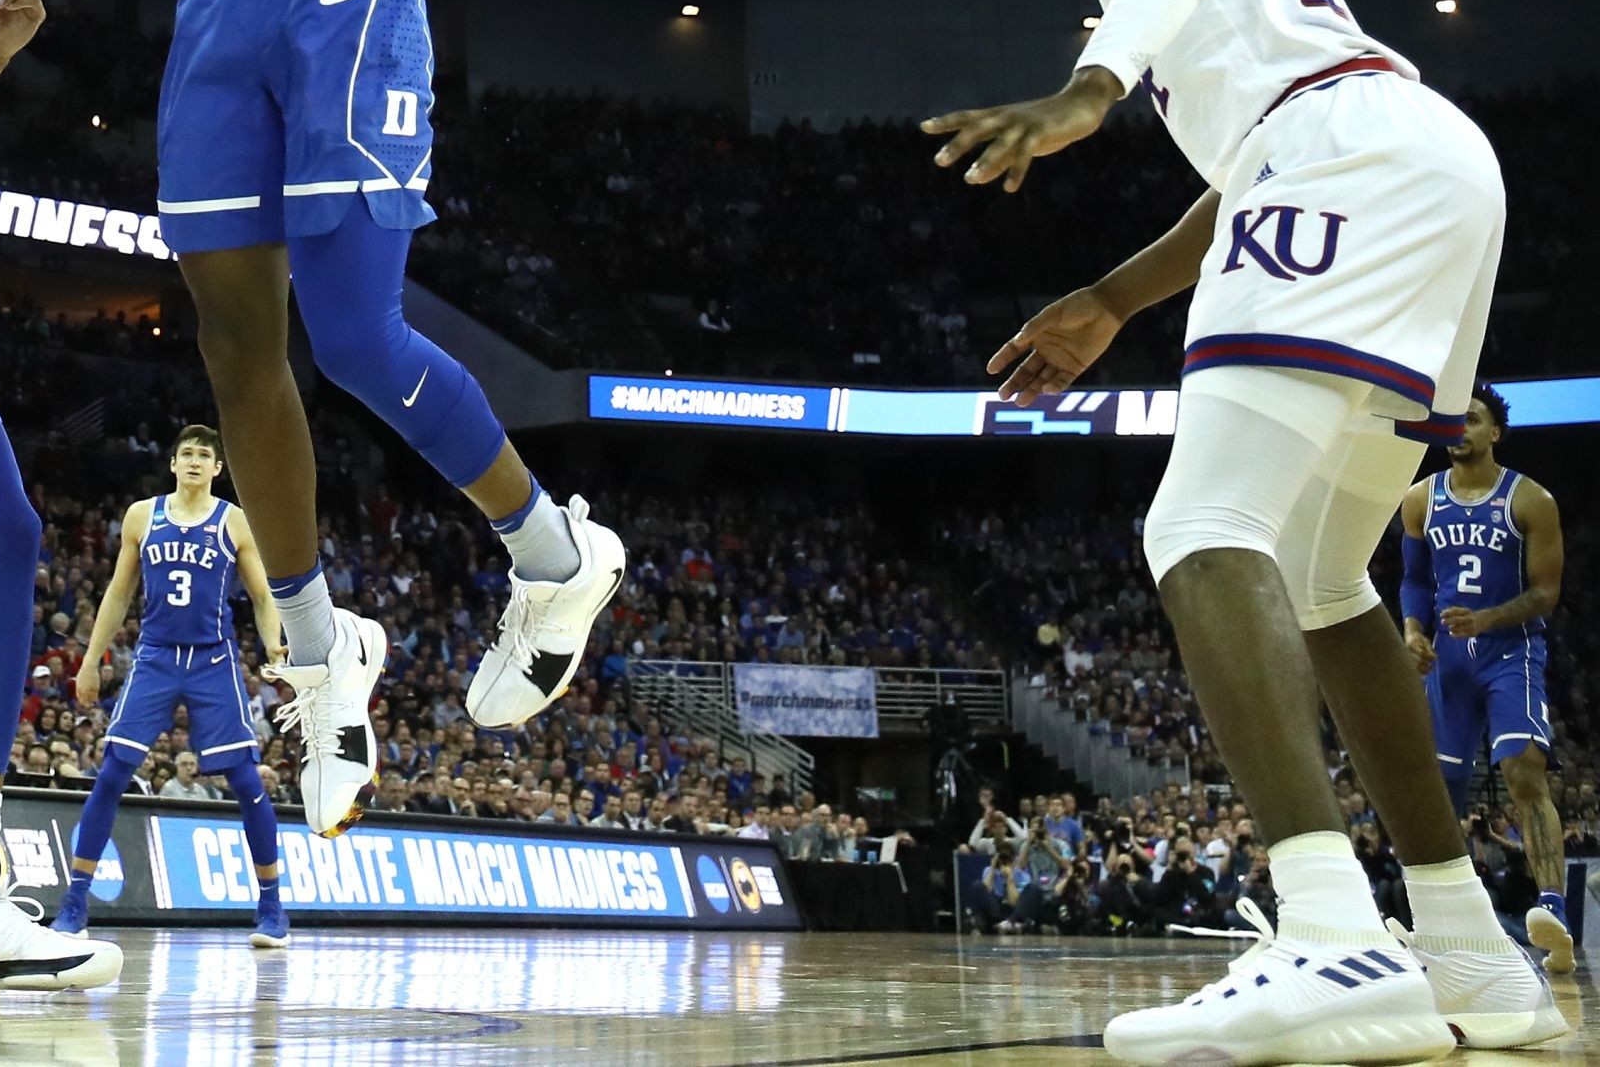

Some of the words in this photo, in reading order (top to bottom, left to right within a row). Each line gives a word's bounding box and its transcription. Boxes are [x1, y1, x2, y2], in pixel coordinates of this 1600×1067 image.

[1221, 205, 1349, 282] KU
[610, 385, 806, 420] #MARCHMADNESS
[146, 541, 219, 570] DUKE
[1428, 523, 1508, 553] DUKE
[166, 569, 192, 607] 3
[1457, 554, 1482, 595] 2
[403, 837, 528, 908] MARCH
[523, 845, 667, 911] MADNESS
